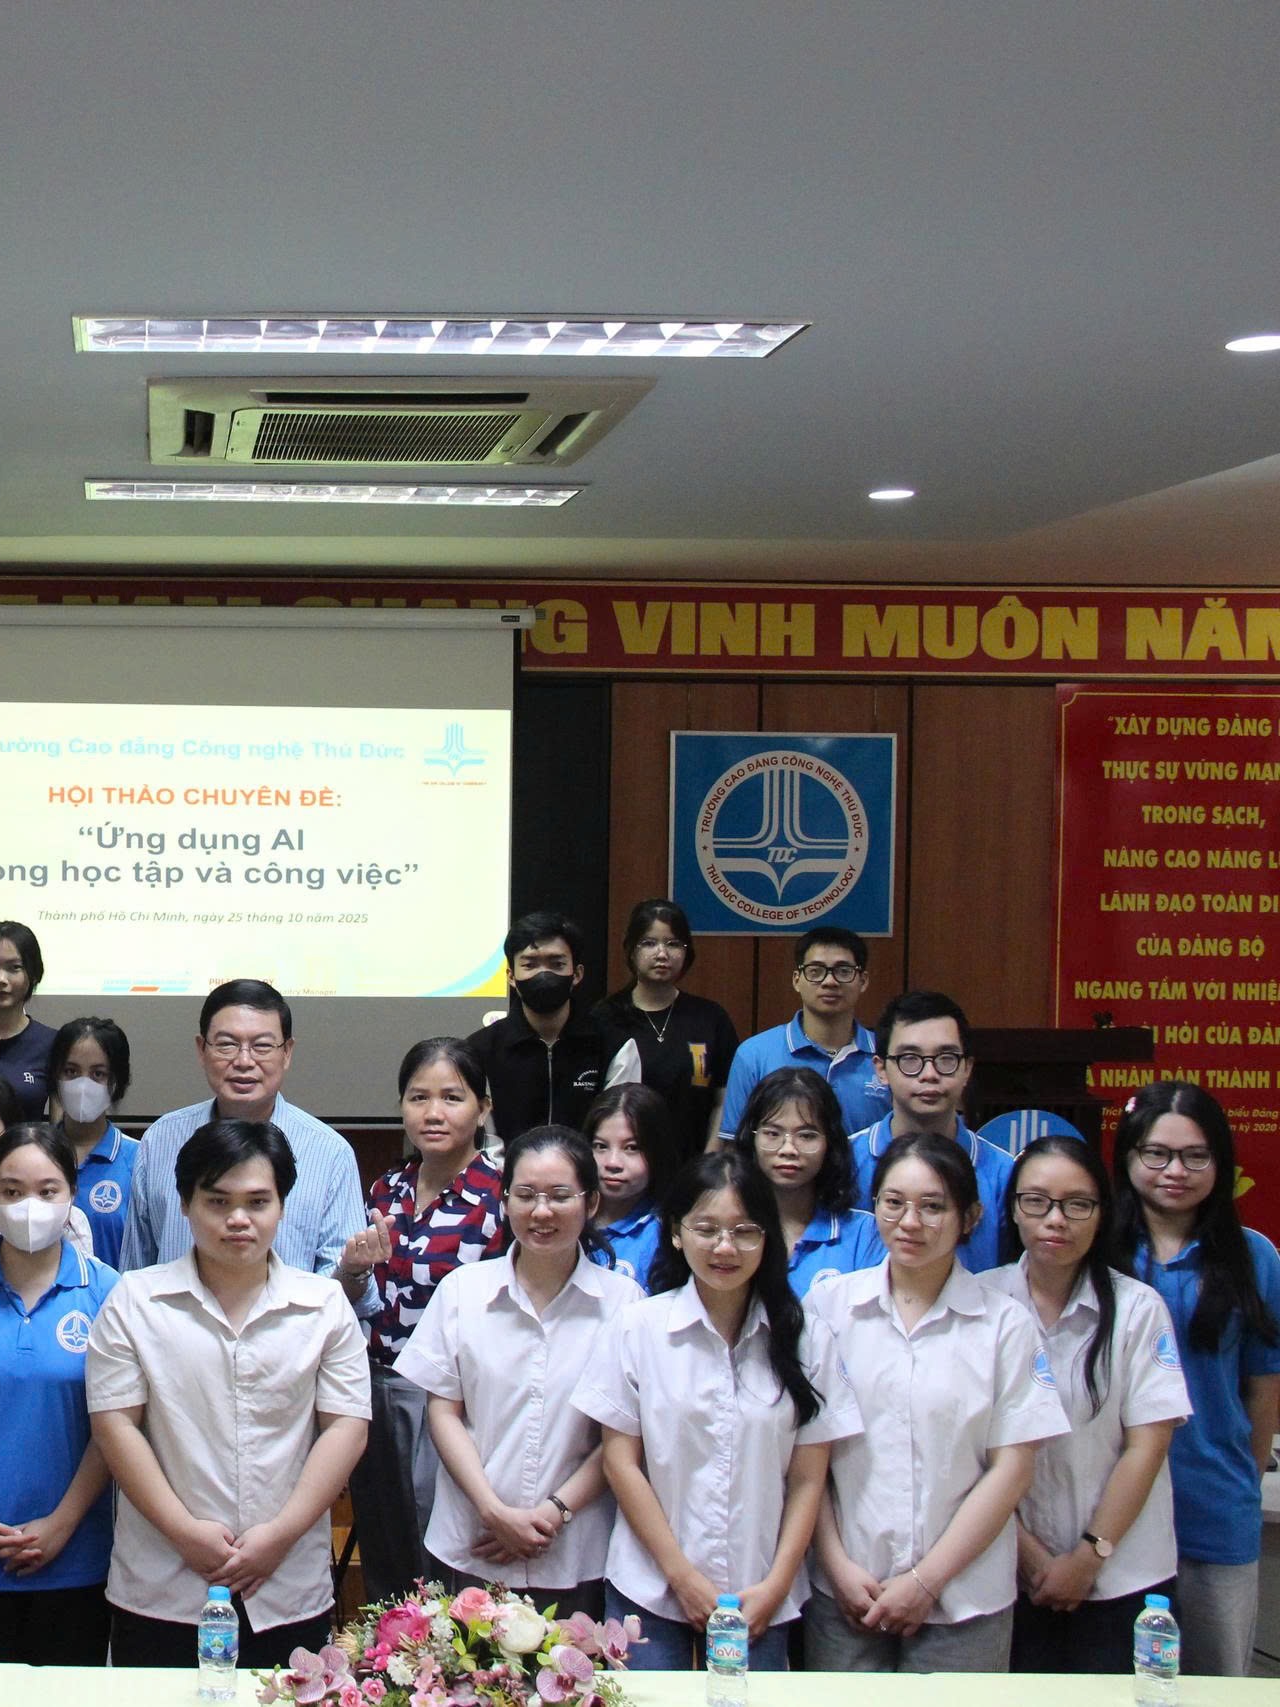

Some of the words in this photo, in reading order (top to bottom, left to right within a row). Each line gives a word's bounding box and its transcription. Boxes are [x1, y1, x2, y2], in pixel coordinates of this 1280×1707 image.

[612, 601, 816, 657] VINH
[842, 595, 1099, 660] MUÔN
[1156, 716, 1211, 740] DỰNG
[69, 738, 113, 755] Cao
[182, 738, 241, 760] Công
[724, 768, 745, 787] CAO
[48, 785, 93, 807] HỘI
[102, 784, 175, 805] THẢO
[183, 785, 291, 806] CHUYÊN
[1141, 805, 1206, 825] TRONG
[178, 828, 261, 856] dụng
[271, 829, 304, 851] AI
[1164, 849, 1201, 868] CAO
[61, 860, 122, 888] học
[132, 860, 184, 888] tập
[195, 861, 232, 884] và
[244, 862, 325, 890] công
[706, 864, 721, 885] THU
[718, 883, 738, 903] DUC
[736, 900, 784, 920] COLLEGE
[786, 910, 800, 920] OF
[801, 864, 857, 916] TECHNOLOGY
[1155, 893, 1197, 917] ĐẠO
[37, 910, 77, 922] Thành
[227, 913, 243, 922] 25
[287, 913, 303, 923] 10
[338, 914, 369, 924] 2025
[1074, 980, 1144, 1000] NGANG
[1206, 1067, 1271, 1089] THÀNH
